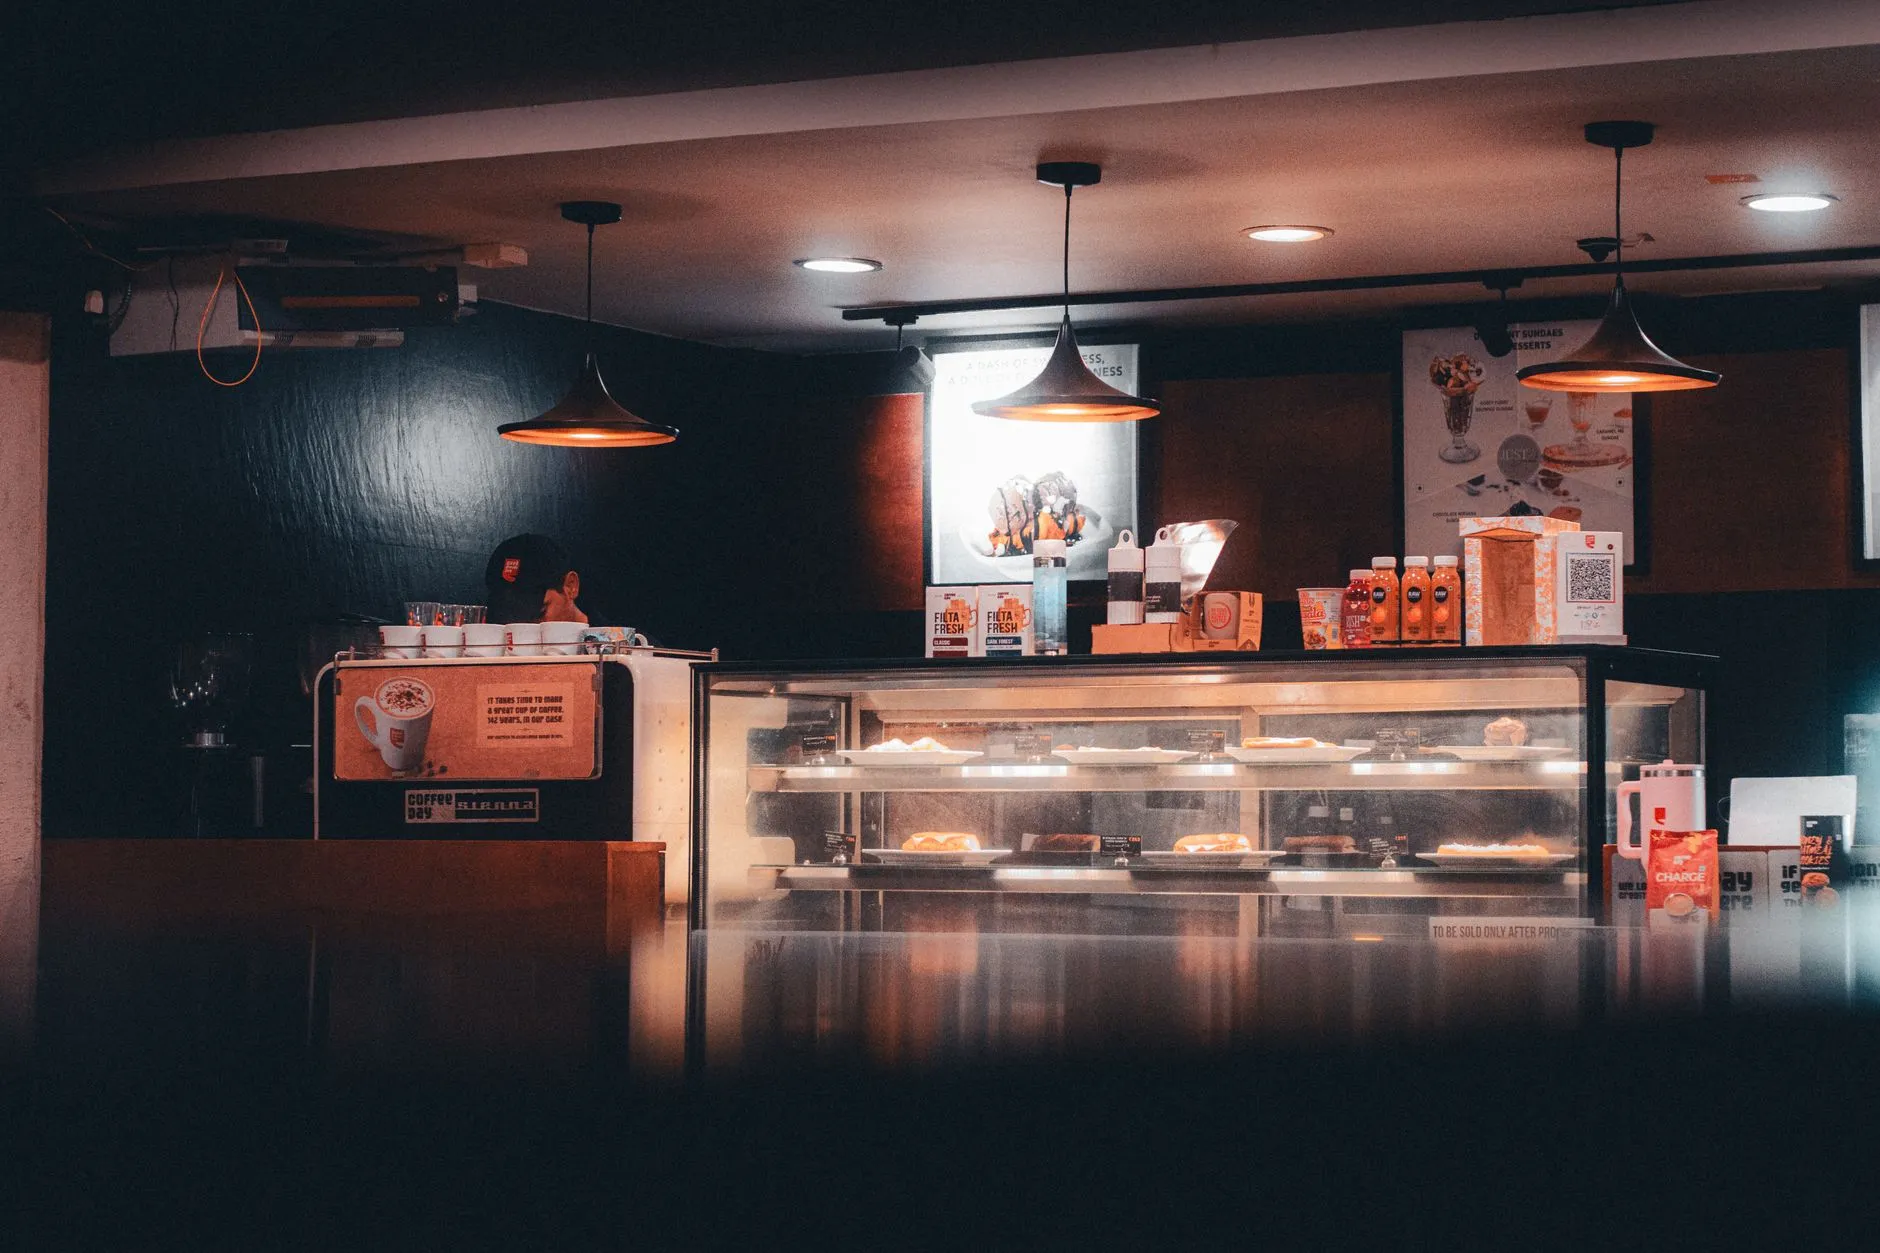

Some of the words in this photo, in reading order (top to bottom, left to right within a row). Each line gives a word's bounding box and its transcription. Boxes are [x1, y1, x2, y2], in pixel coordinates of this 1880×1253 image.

[1522, 328, 1564, 338] SUNDAES
[1512, 341, 1551, 350] ESSERTS
[934, 611, 960, 622] FILTA
[987, 611, 1013, 622] FILTA
[934, 623, 965, 634] FRESH
[987, 622, 1018, 634] FRESH
[1656, 871, 1705, 883] CHARGE
[1433, 926, 1443, 938] TO
[1447, 926, 1457, 938] BE
[1459, 926, 1482, 938] SOLD
[1484, 925, 1505, 938] ONLY
[1508, 925, 1536, 938] AFTER
[1539, 926, 1559, 938] PRO
